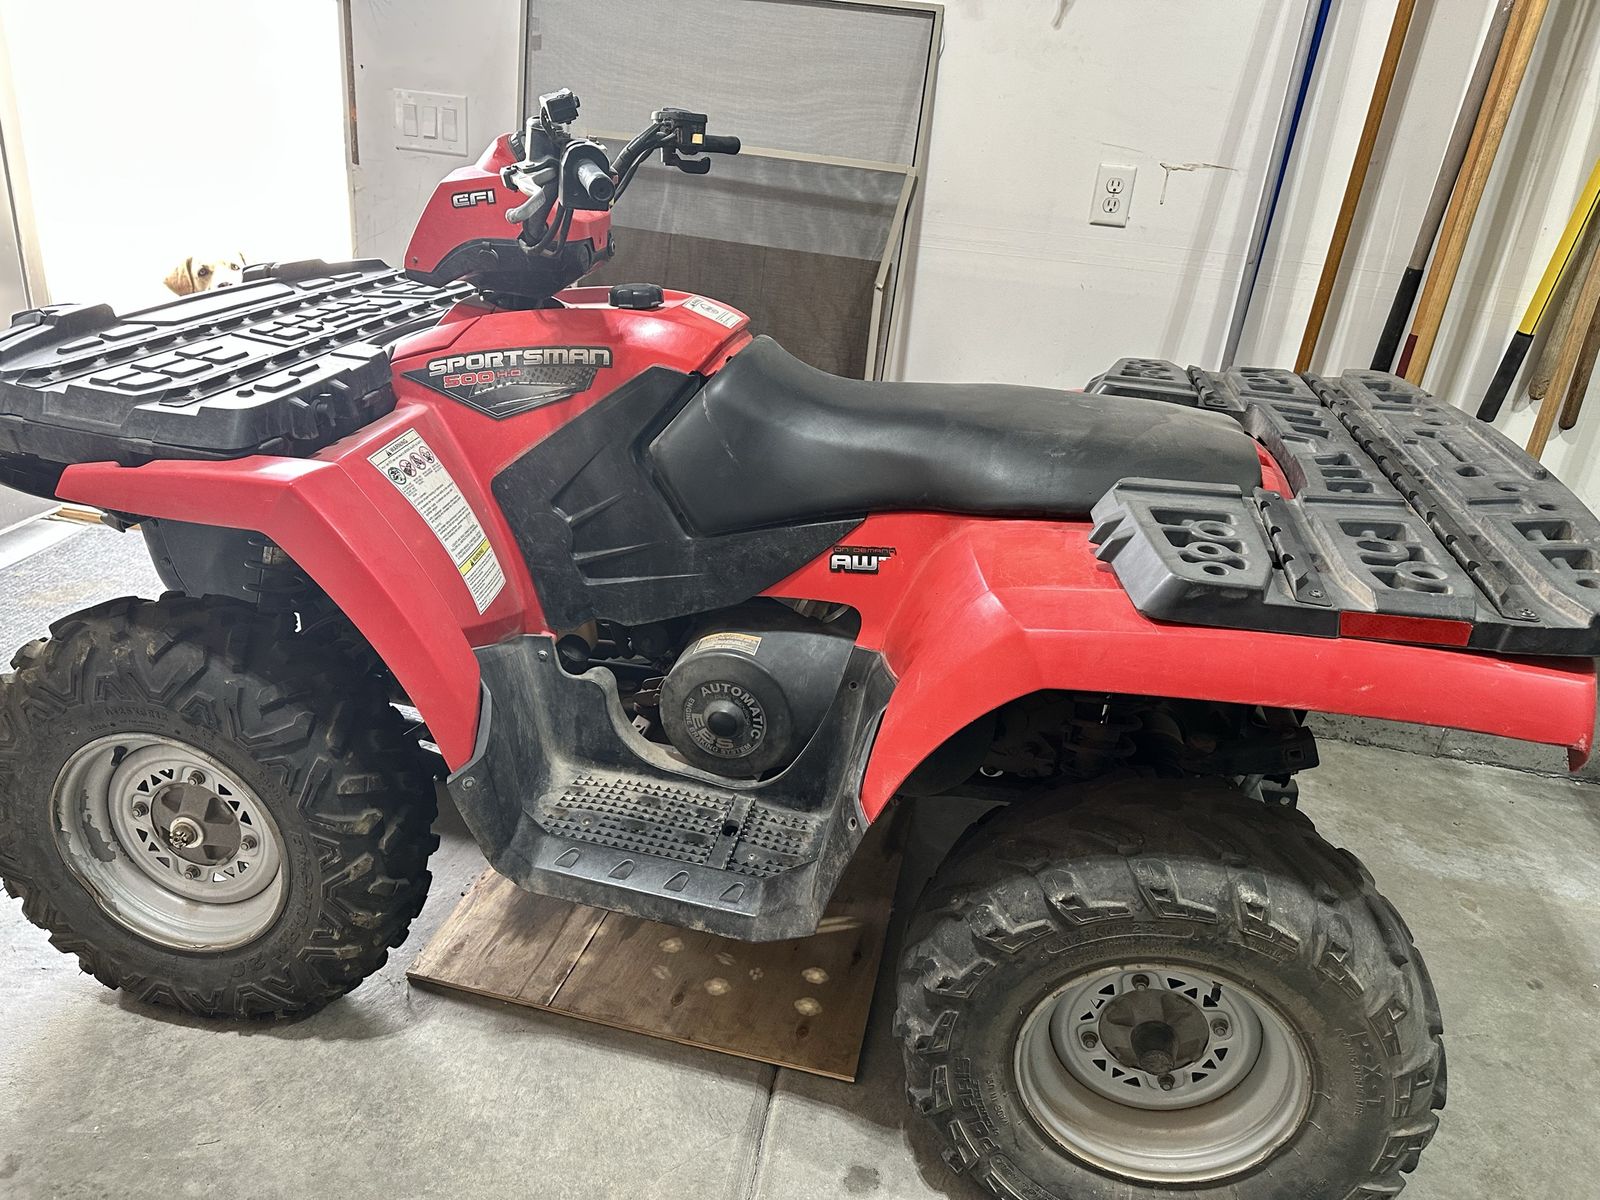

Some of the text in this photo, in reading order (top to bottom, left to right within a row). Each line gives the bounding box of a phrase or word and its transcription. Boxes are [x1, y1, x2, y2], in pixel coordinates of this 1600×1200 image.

[451, 189, 495, 208] EFI
[428, 348, 612, 377] SPORTSMAN
[443, 371, 495, 389] 500
[831, 554, 892, 571] AW
[685, 697, 697, 726] ENGINE
[701, 683, 764, 741] AUTOMATIC
[689, 726, 719, 753] BRAKING
[691, 713, 734, 749] EBS
